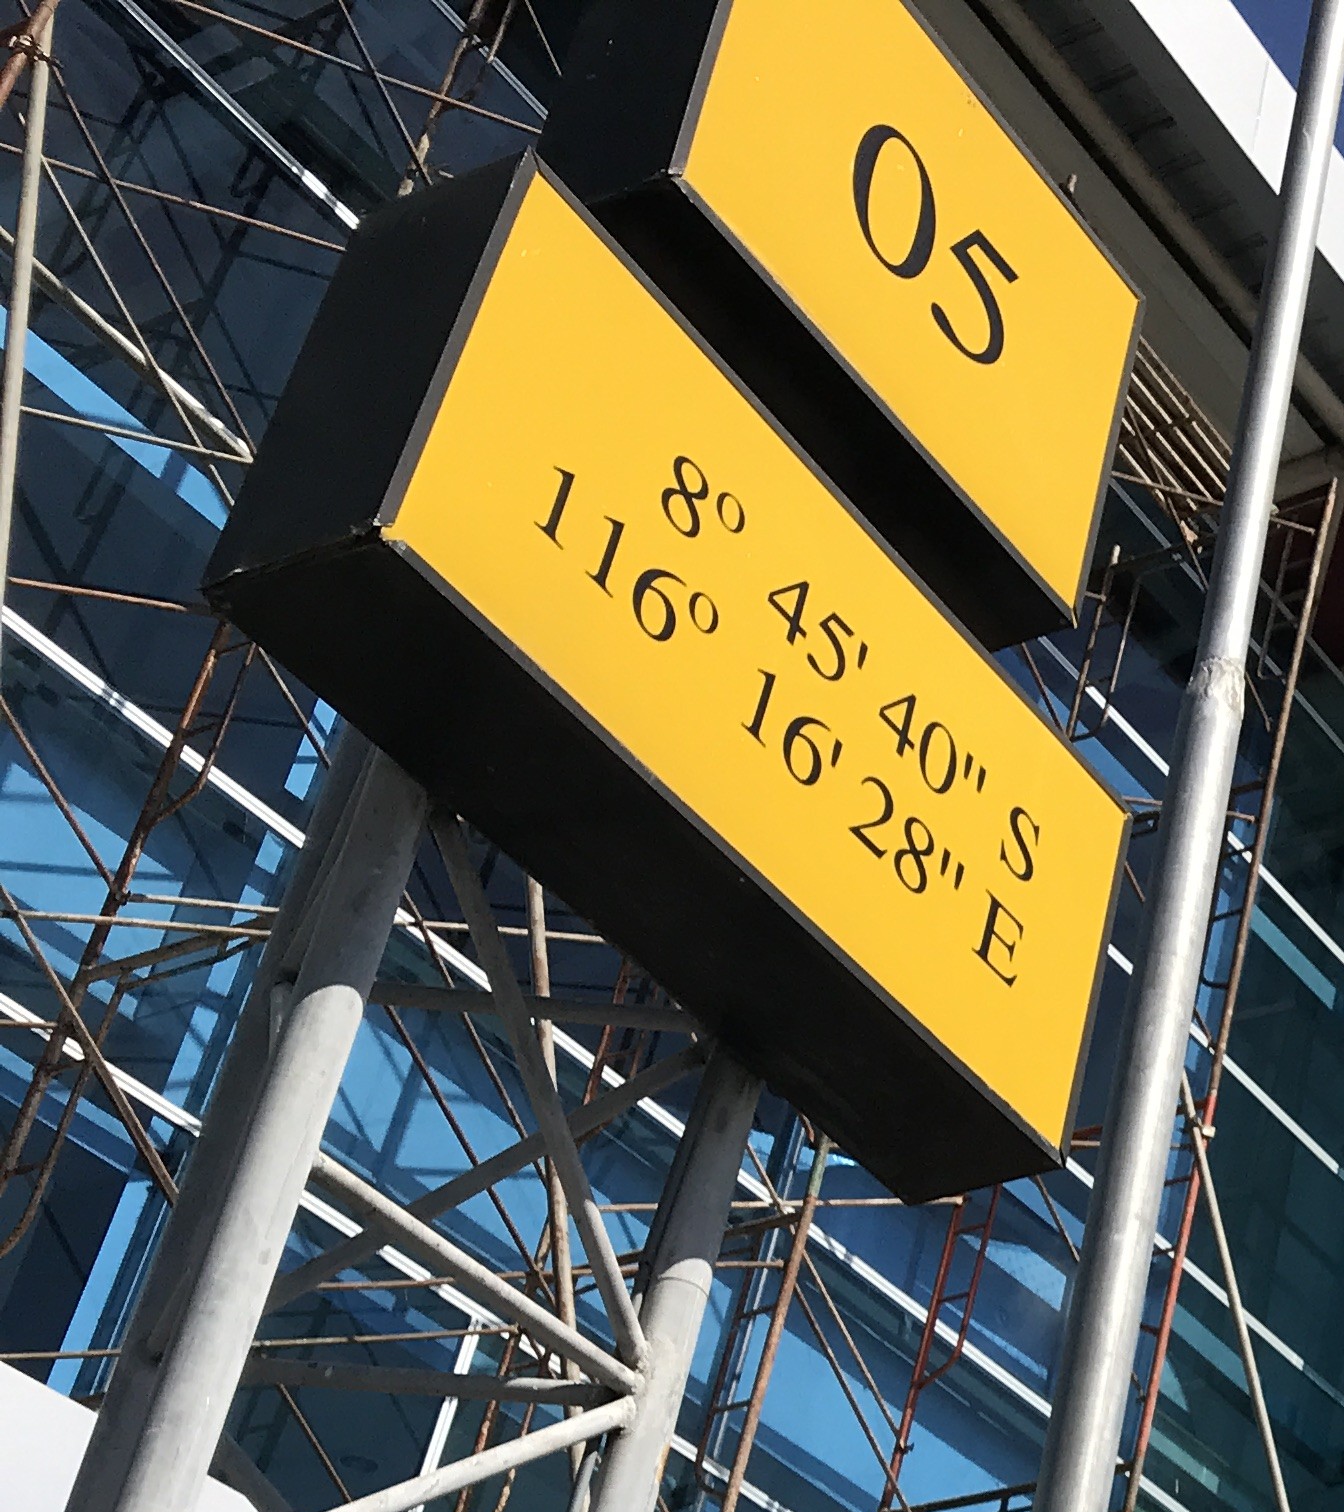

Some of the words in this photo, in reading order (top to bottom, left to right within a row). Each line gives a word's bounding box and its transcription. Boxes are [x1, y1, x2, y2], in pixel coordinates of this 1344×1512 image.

[852, 124, 1020, 365] 05
[999, 806, 1040, 882] S
[973, 892, 1025, 988] E
